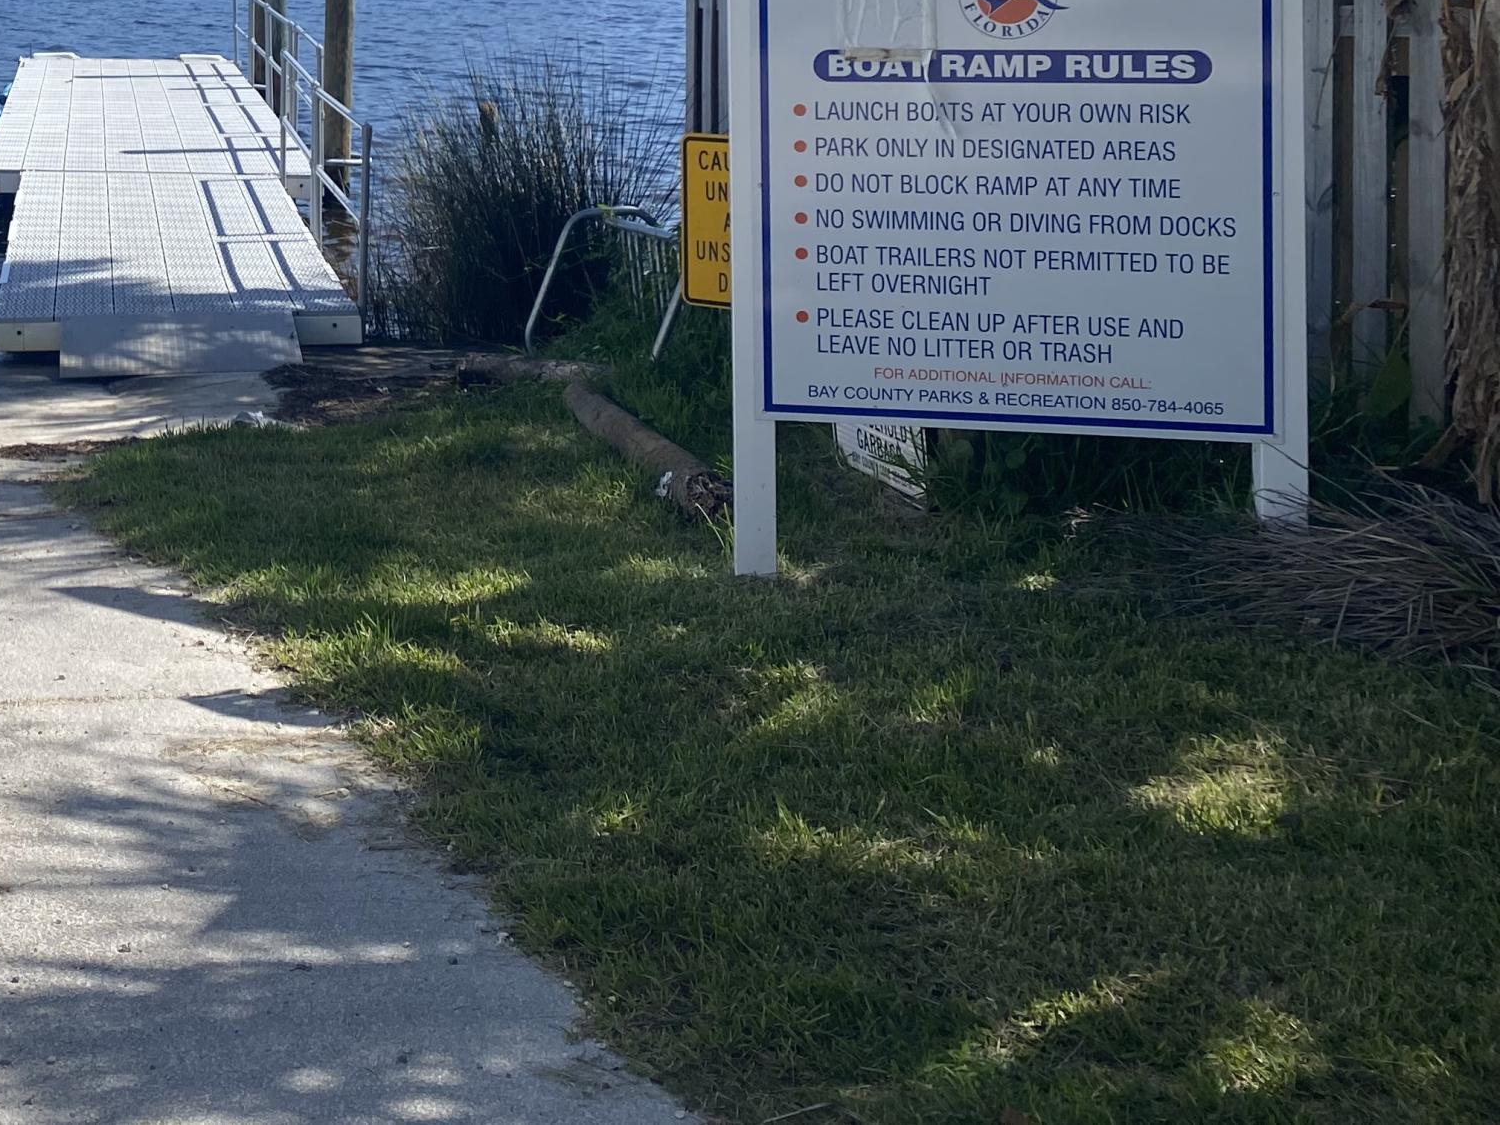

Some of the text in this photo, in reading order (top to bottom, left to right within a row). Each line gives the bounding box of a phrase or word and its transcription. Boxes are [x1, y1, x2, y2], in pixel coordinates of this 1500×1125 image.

[964, 2, 1049, 37] FLORIDA
[828, 54, 1196, 79] BOAT RAMP RULES
[815, 99, 898, 121] LAUNCH
[981, 102, 1006, 125] AT
[1012, 103, 1071, 123] YOUR
[1080, 103, 1131, 123] OWN
[1140, 104, 1191, 124] RISK
[815, 137, 1175, 161] PARK ONLY IN DESIGNATED AREAS
[815, 171, 1180, 198] DO NOT BLOCK RAMP AT ANY TIME
[816, 208, 1236, 237] NO SWIMMING OR DIVING FROM DOCKS
[817, 245, 1230, 274] BOAT TRAILERS NOT PERMITTED TO BE
[817, 272, 991, 296] LEFT OVERNIGHT
[817, 308, 1183, 339] PLEASE CLEAN UP AFTER USE AND
[818, 334, 1111, 363] LEAVE NO LITTER OR TRASH
[875, 368, 1151, 389] FOR ADDITIONAL INFORMATION CALL:
[808, 385, 1224, 416] BAY COUNTY PARKS & RECREATION 850-784-4065
